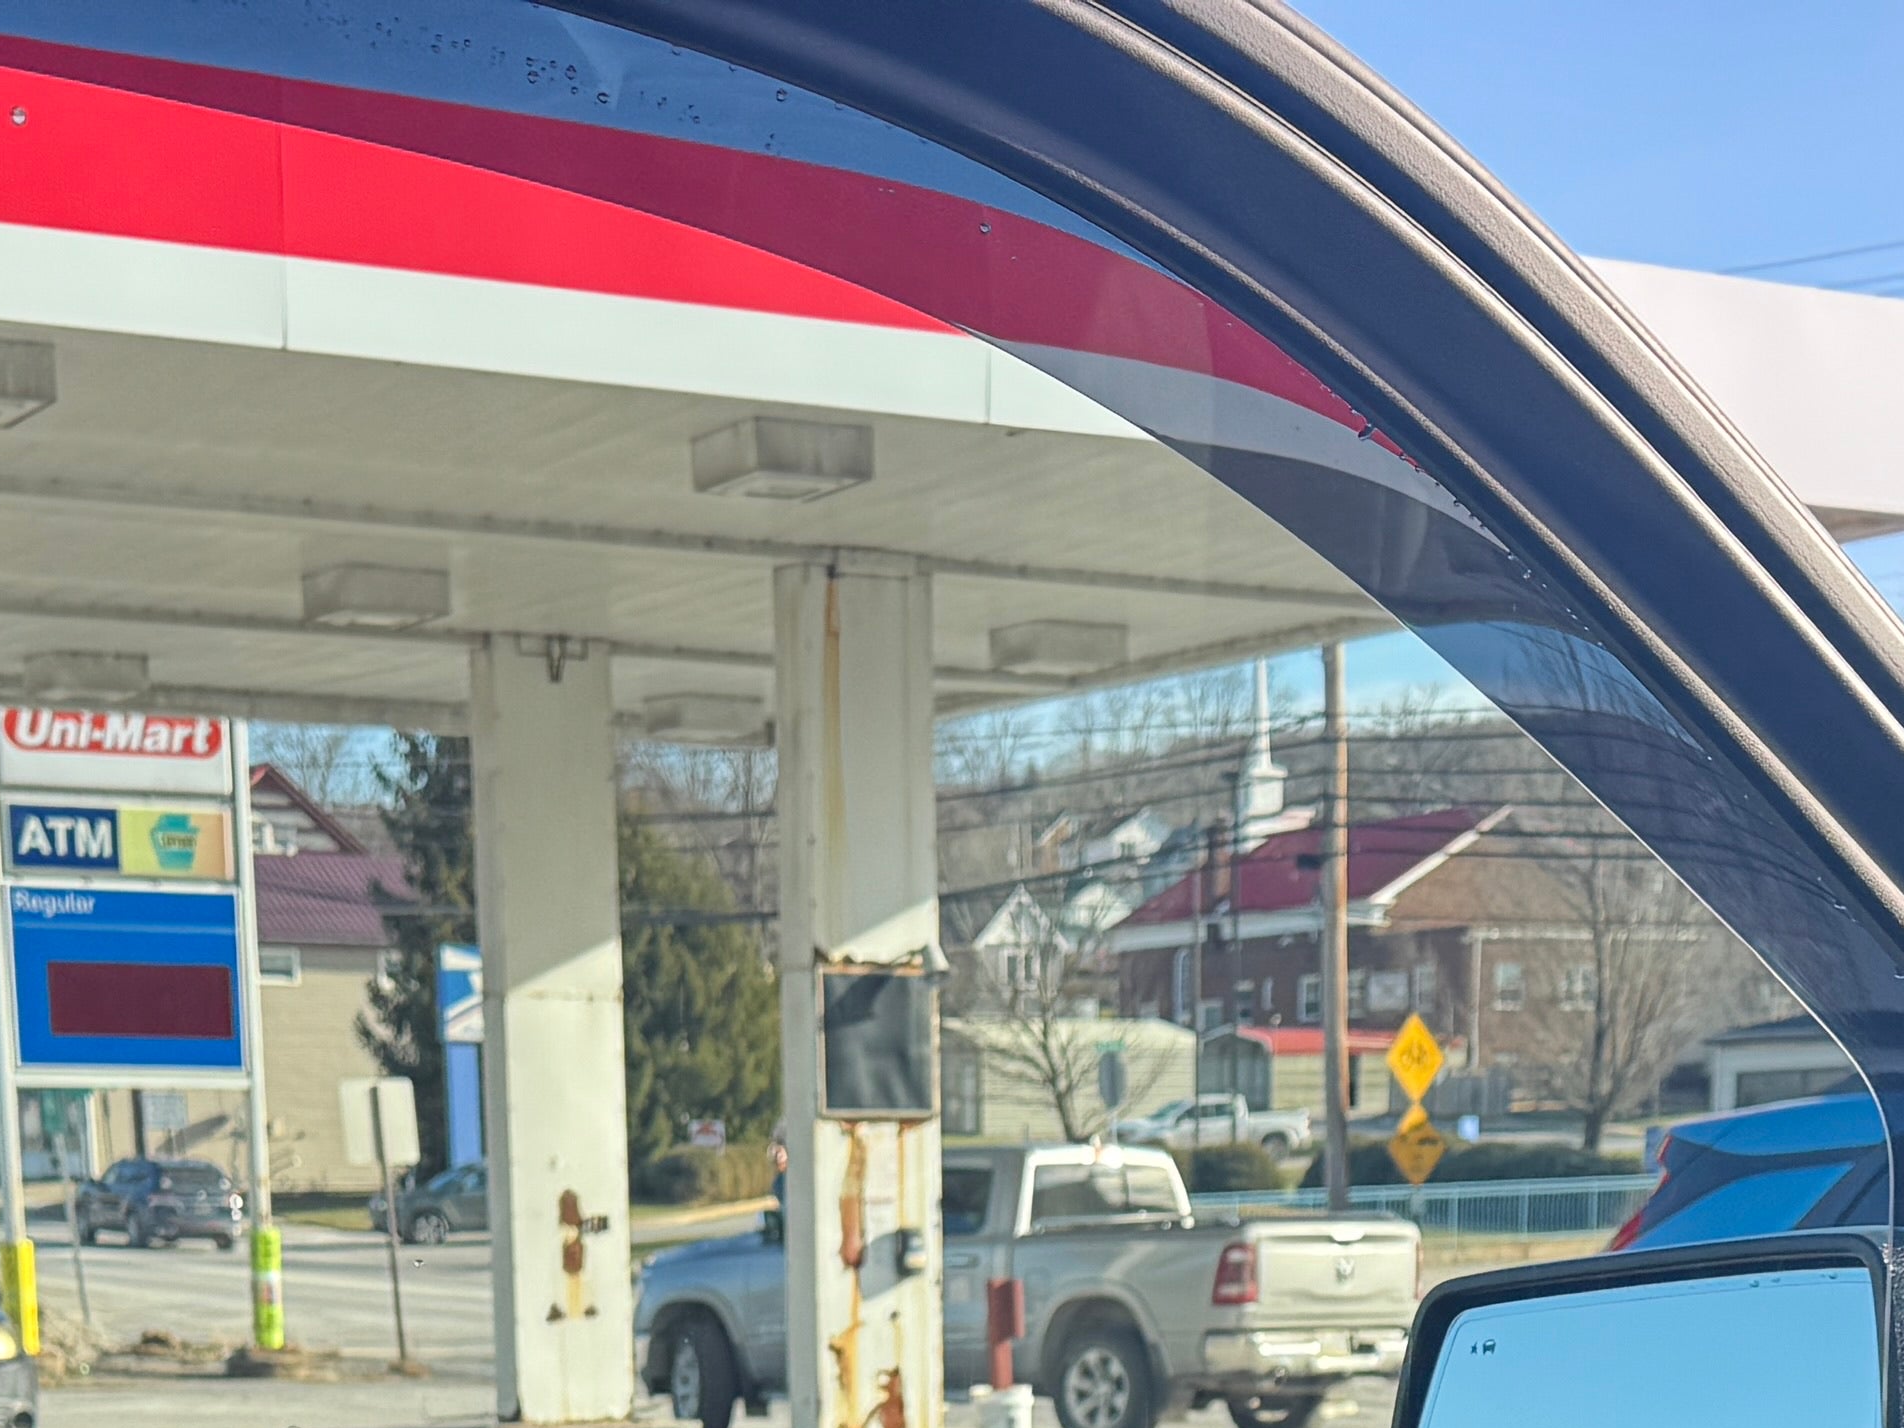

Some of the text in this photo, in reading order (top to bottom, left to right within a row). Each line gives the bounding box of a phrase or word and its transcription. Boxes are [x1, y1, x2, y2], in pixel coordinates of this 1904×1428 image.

[13, 708, 214, 755] Uni-Mart
[18, 815, 114, 860] ATM
[14, 890, 96, 918] Regular
